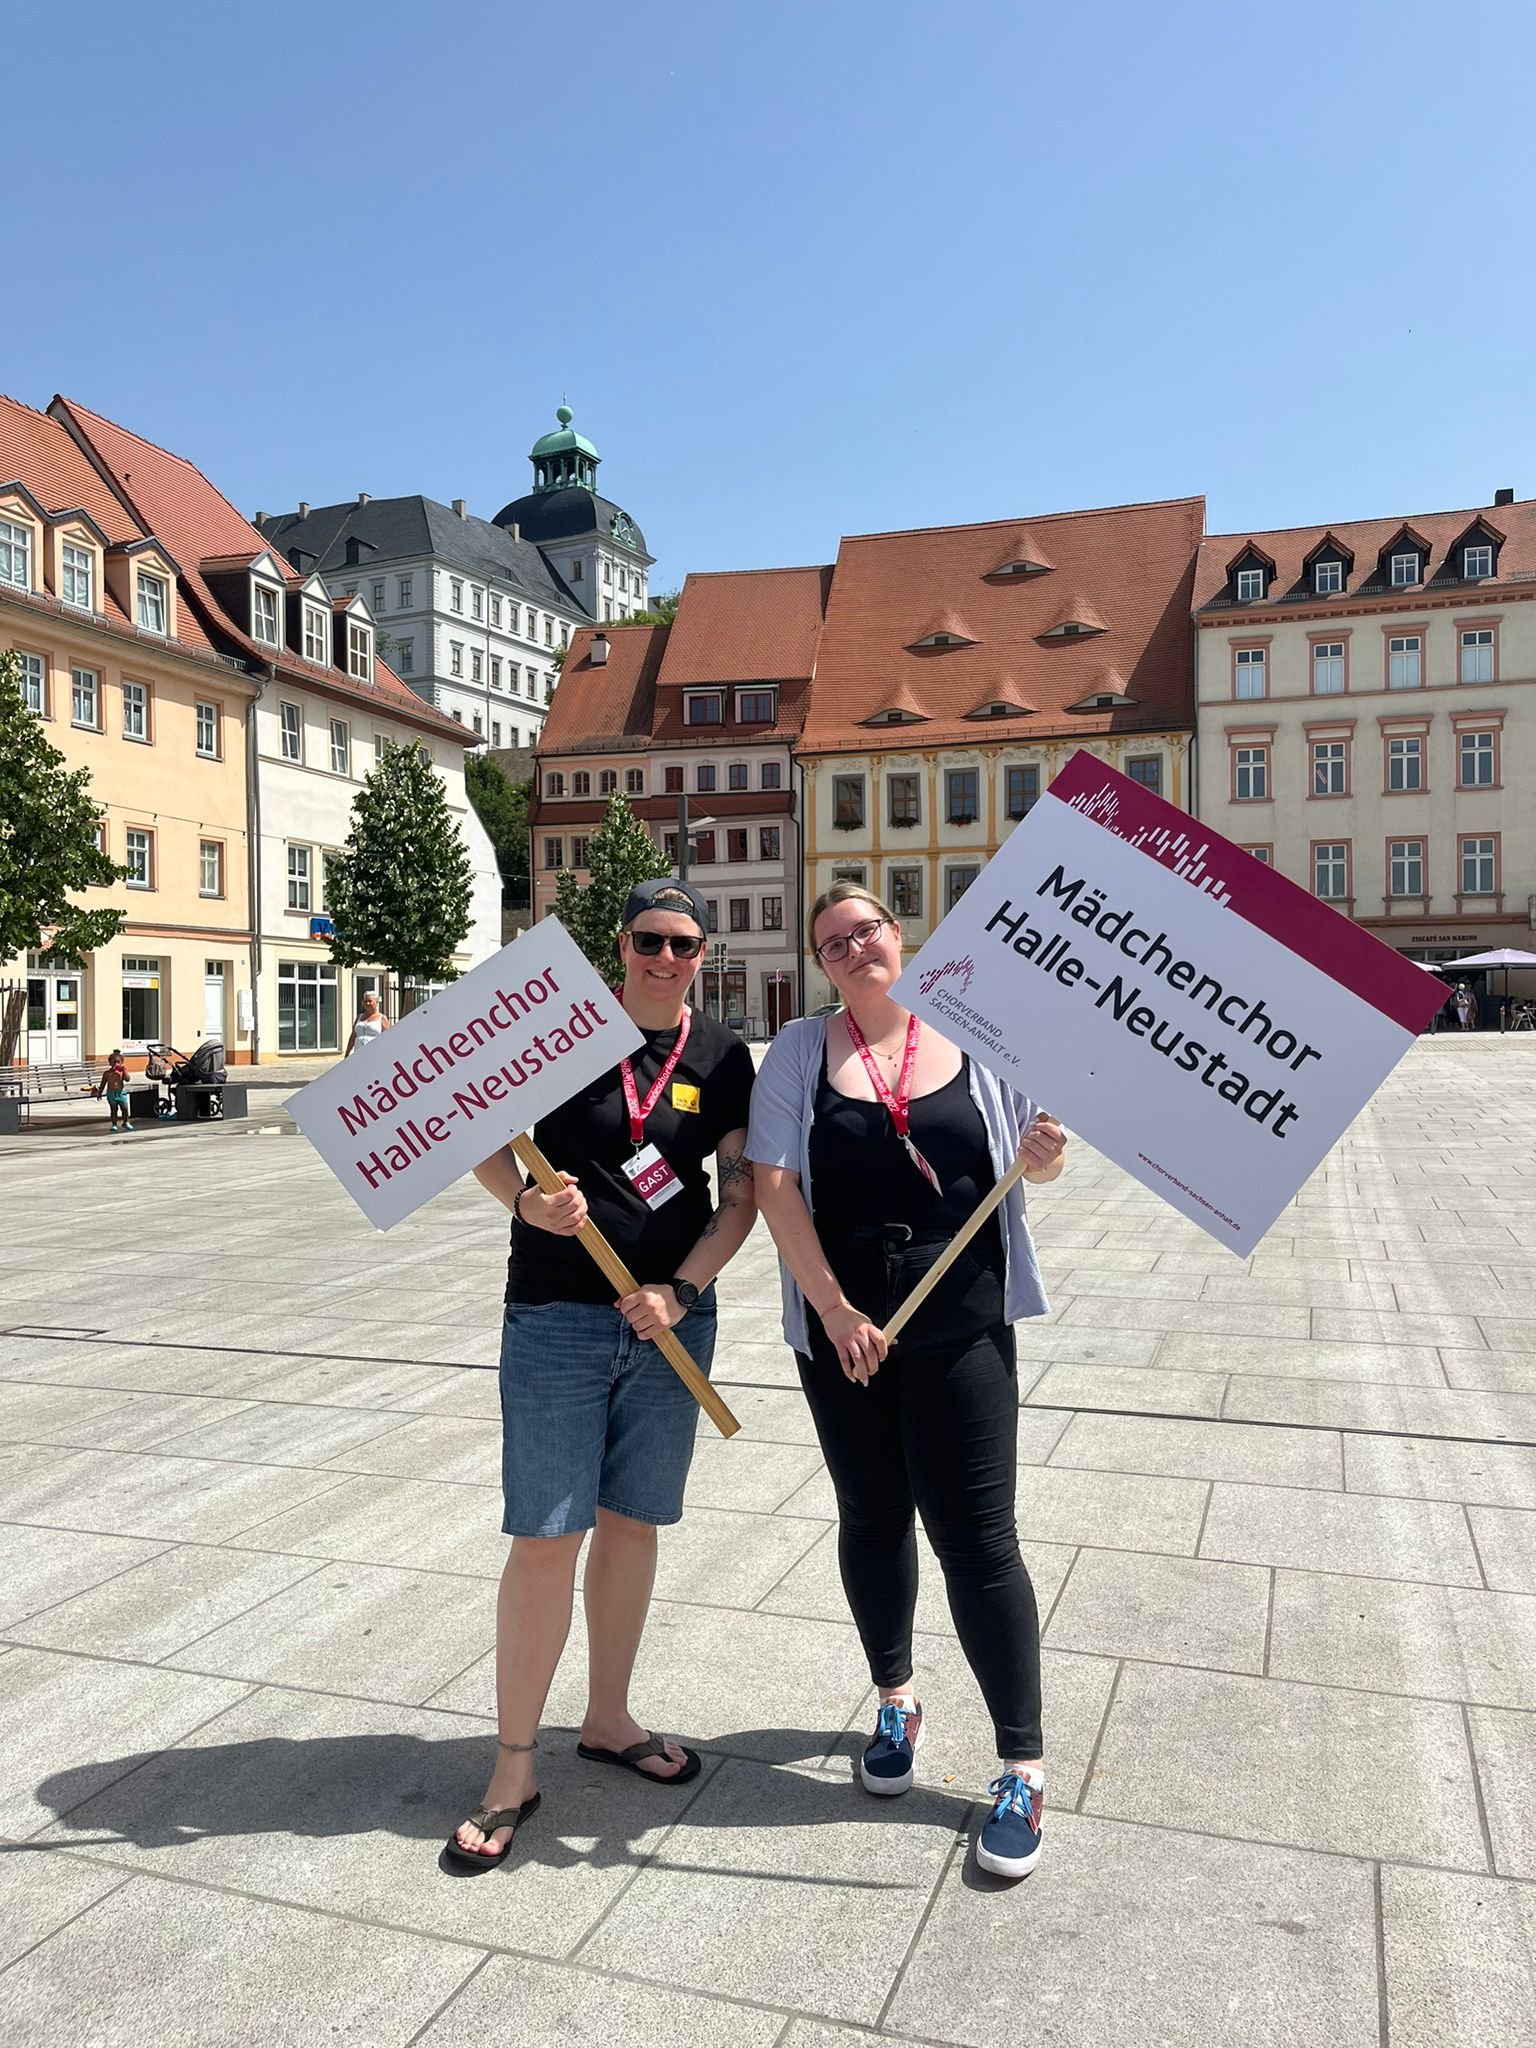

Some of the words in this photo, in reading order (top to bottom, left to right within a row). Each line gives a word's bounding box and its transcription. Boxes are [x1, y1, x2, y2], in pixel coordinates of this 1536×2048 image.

[1036, 865, 1323, 1071] Mädchenchor
[928, 997, 1006, 1054] SACHSEN-ANHALT
[1003, 1052, 1021, 1067] e.V.
[937, 988, 1003, 1038] CHORVERBAND
[984, 900, 1300, 1139] Halle-Neustadt
[337, 966, 560, 1136] Mädchenchor
[620, 1058, 635, 1096] eißenfels
[356, 998, 608, 1189] Halle-Neustadt
[627, 1096, 640, 1119] 2022
[642, 1056, 678, 1111] Landeschorfest
[882, 1093, 900, 1112] 2022
[638, 1164, 669, 1193] GAST
[1138, 1152, 1241, 1231] www.chorverband-sachsen-anhalt.de
